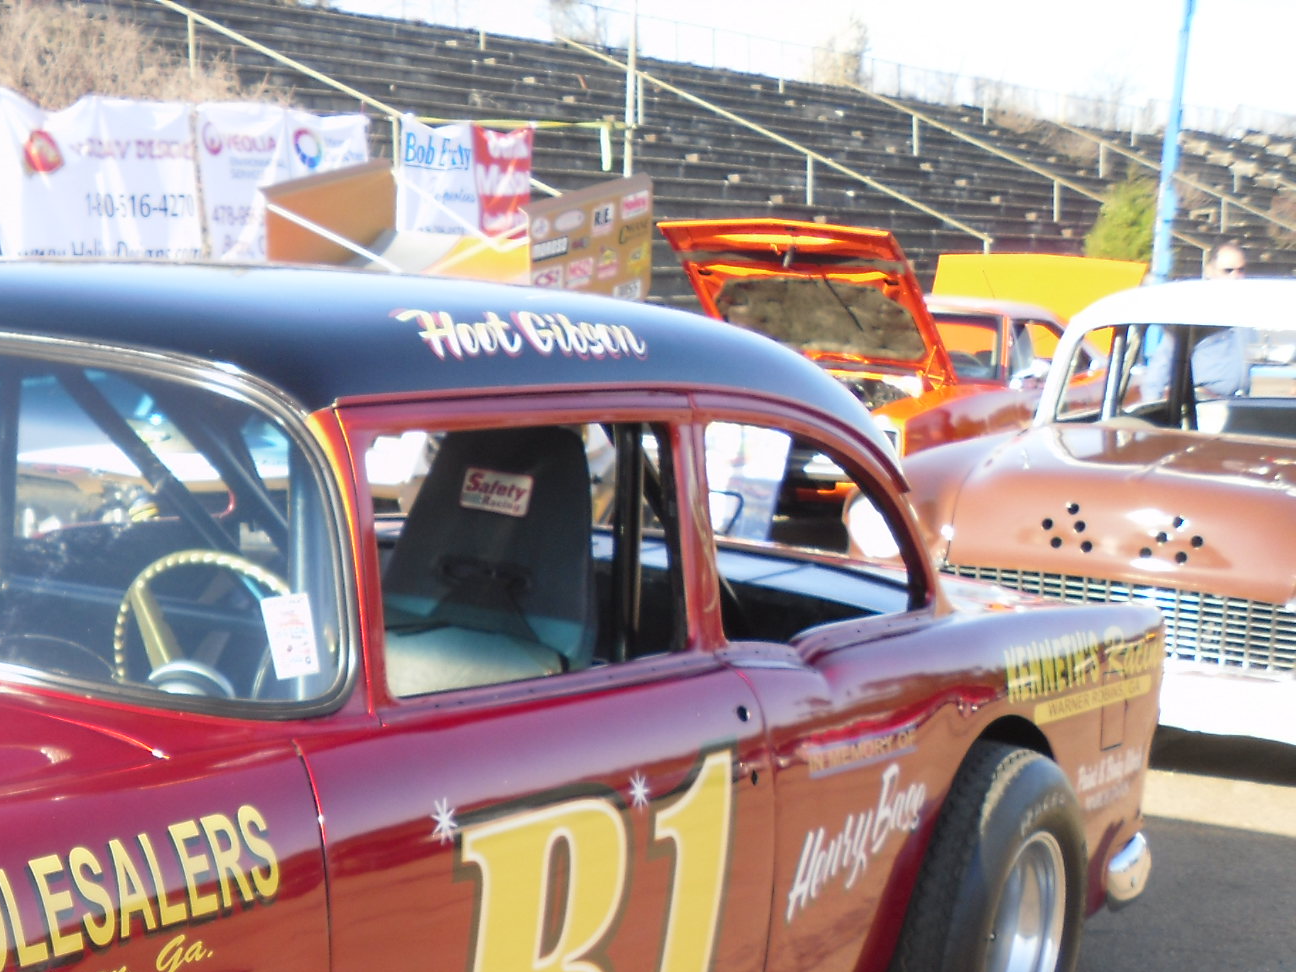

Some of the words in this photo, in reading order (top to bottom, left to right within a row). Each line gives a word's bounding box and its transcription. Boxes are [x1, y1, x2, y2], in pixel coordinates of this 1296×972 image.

[405, 132, 435, 165] Bob
[389, 308, 521, 359] Hoot
[509, 310, 648, 361] Gibson
[466, 471, 528, 503] Safety
[829, 735, 896, 768] MEMORY
[898, 728, 917, 751] OF
[787, 807, 873, 922] Henry
